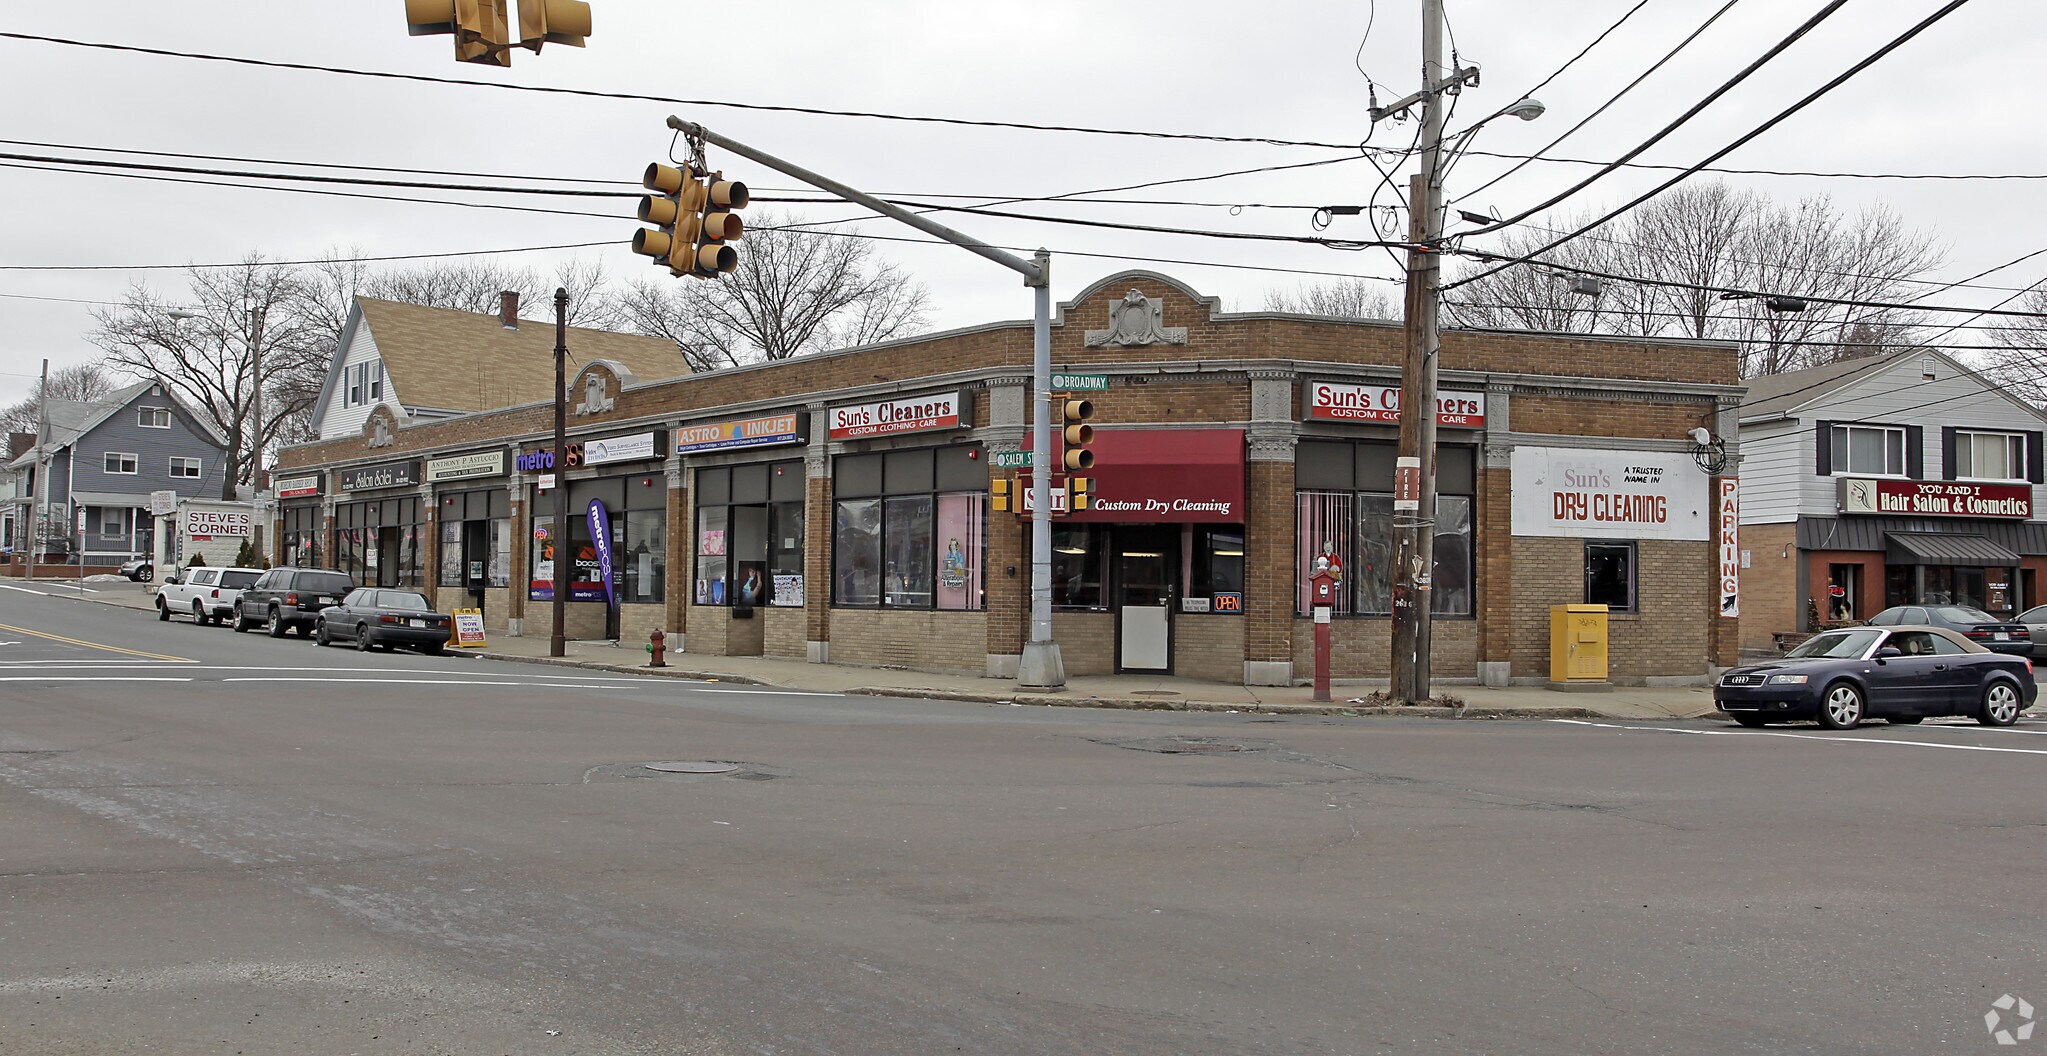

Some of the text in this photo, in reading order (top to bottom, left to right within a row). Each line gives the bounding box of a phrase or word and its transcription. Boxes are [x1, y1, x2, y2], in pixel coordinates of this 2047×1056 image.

[1065, 376, 1106, 389] BROADWAY
[1317, 385, 1371, 408] Sun's
[838, 401, 951, 428] Sun's Cleaners
[1331, 409, 1377, 419] CUSTOM
[1441, 415, 1467, 424] CARE
[680, 417, 794, 443] ASTRO INKJET
[848, 418, 937, 435] CUSTOM CLOTHING CARE
[431, 460, 459, 468] ANTHONY
[469, 454, 499, 463] ASTUCCIO
[1006, 453, 1024, 465] SALEM
[1624, 466, 1664, 475] A TRUSTED
[355, 472, 374, 488] Salon
[1564, 468, 1611, 488] Sun's
[1624, 475, 1661, 484] NAME IN
[1917, 484, 1981, 495] YOU AND I
[1095, 499, 1231, 515] Custom Dry Cleaning
[1880, 492, 2028, 516] Hair Salon & Cosmetics
[190, 512, 249, 524] STEVE'S
[188, 523, 248, 535] CORNER
[591, 505, 611, 576] metroPCS
[1722, 482, 1736, 594] PARKING
[575, 558, 600, 567] boos
[1215, 596, 1240, 610] OPEN
